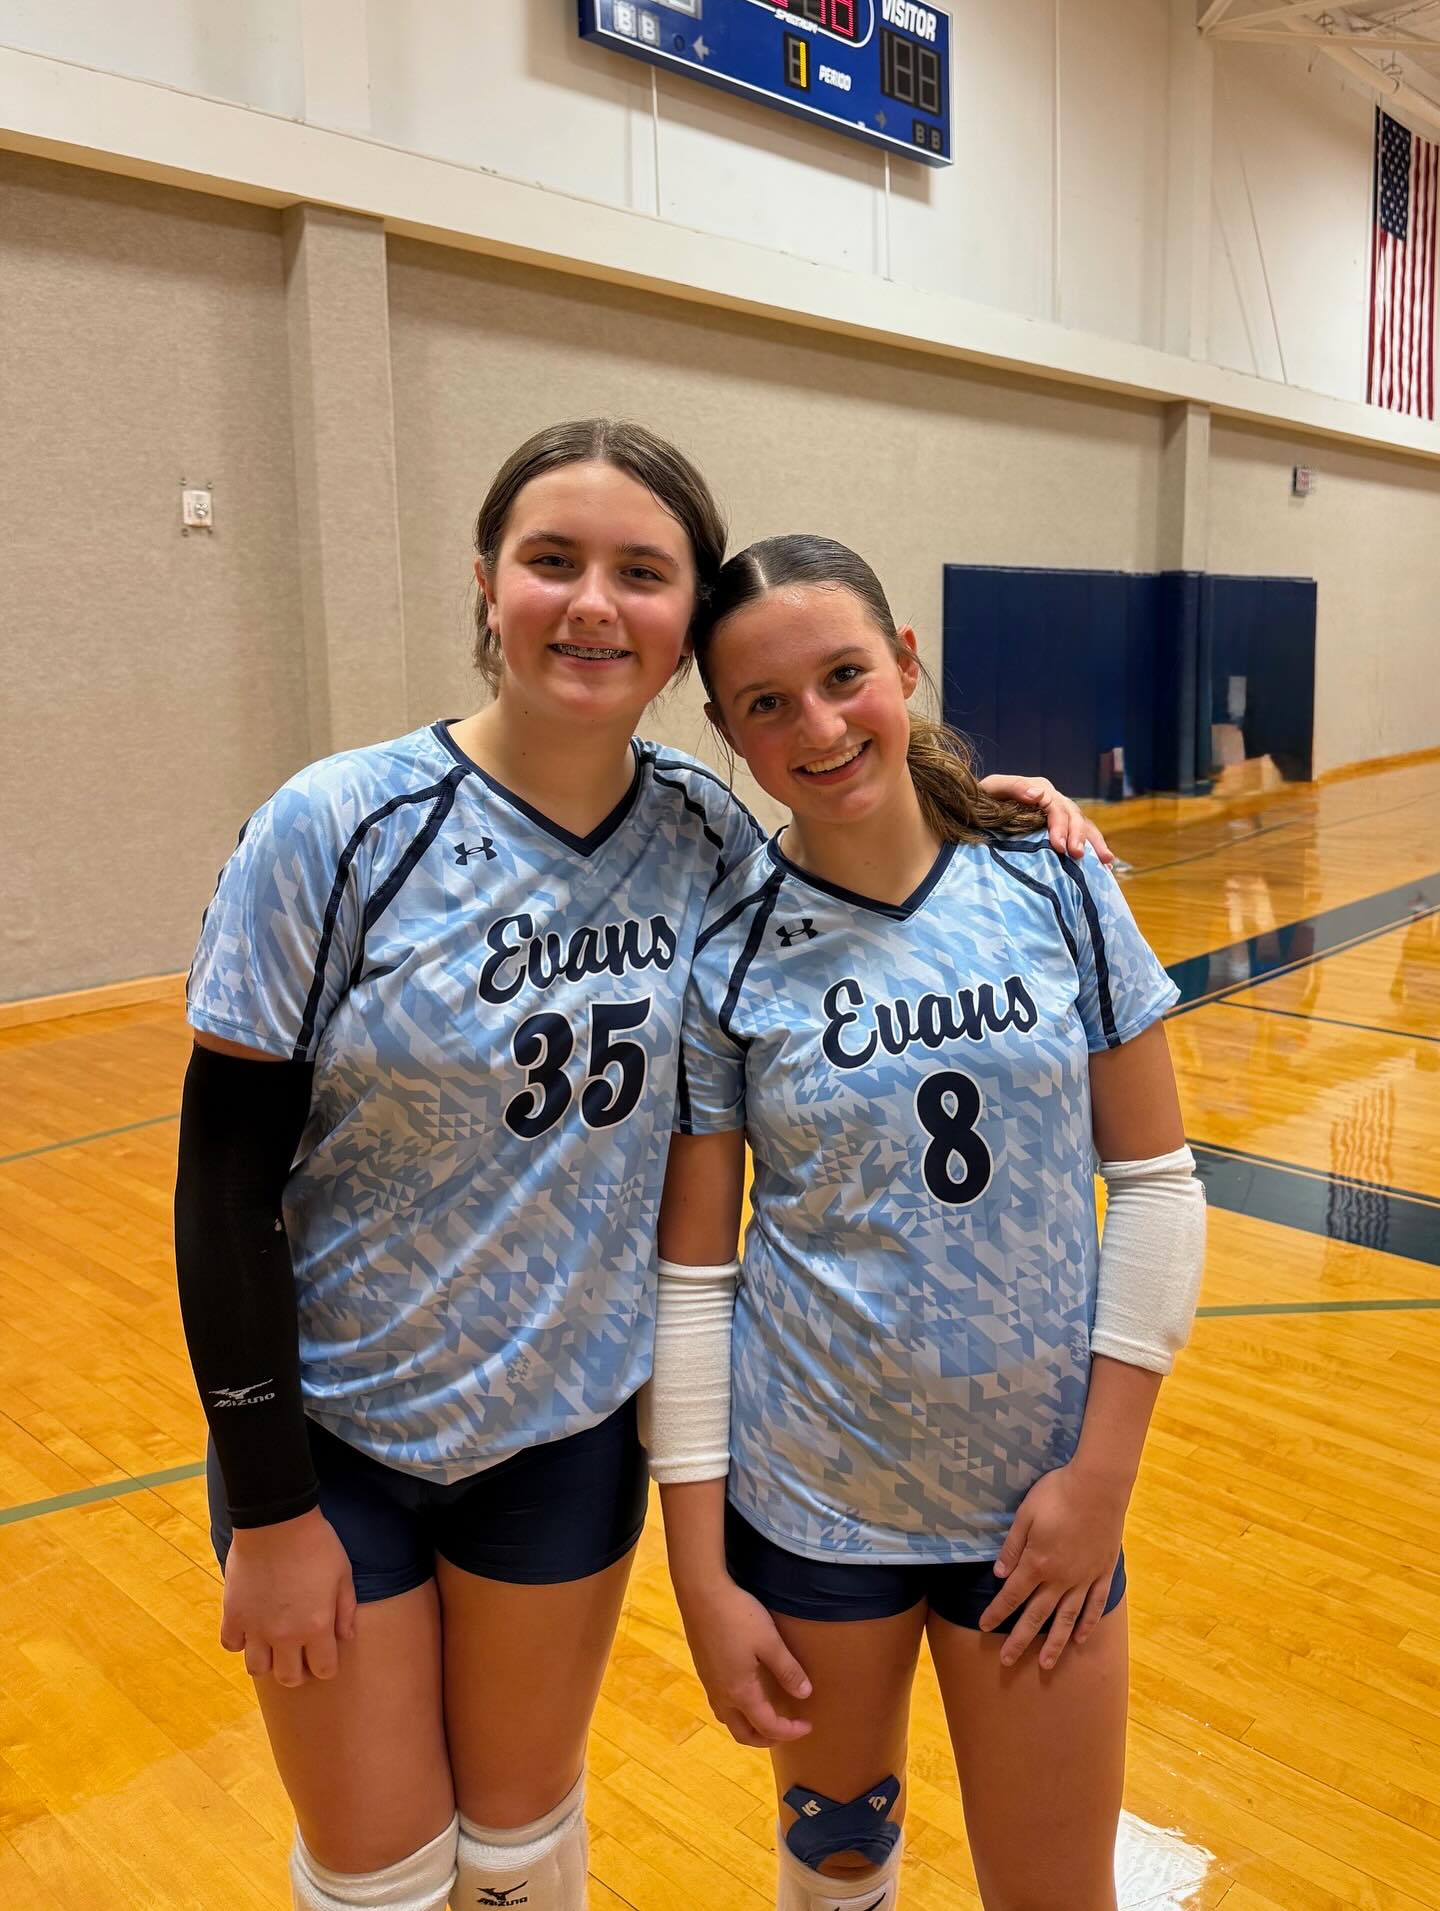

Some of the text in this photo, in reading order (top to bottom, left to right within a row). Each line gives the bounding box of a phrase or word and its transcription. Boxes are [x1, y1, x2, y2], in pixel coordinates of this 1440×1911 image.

[881, 0, 937, 42] VISITOR
[477, 911, 678, 1005] Evans
[502, 996, 653, 1141] 35
[821, 974, 1039, 1070] Evans
[912, 1068, 995, 1206] 8
